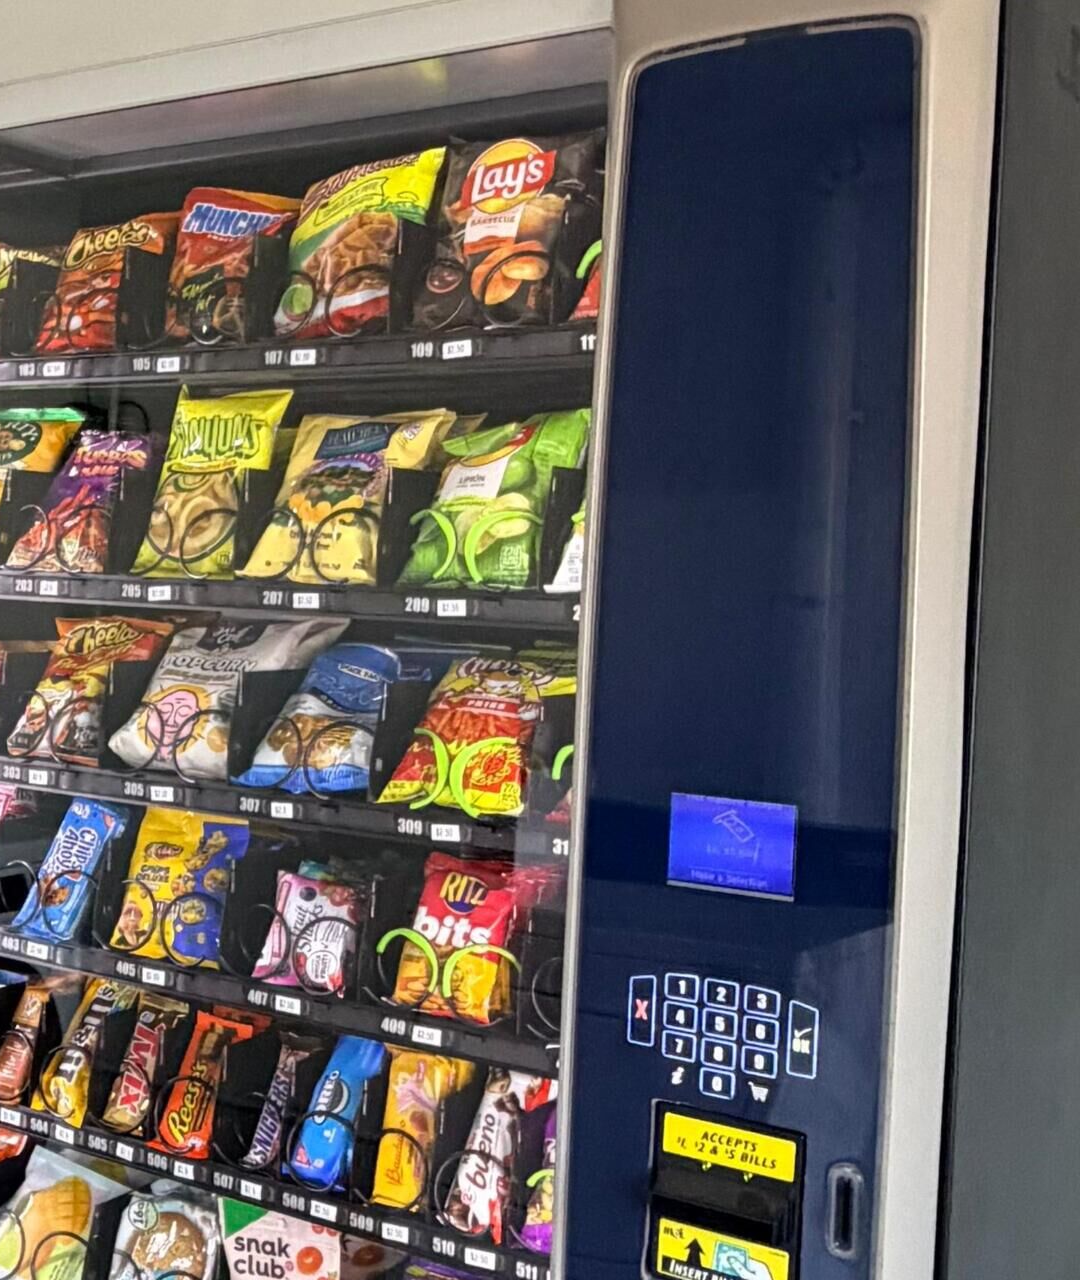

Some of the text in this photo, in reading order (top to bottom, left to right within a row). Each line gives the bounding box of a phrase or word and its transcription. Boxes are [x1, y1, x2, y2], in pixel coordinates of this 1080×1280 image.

[471, 153, 545, 205] Lay's
[411, 342, 433, 357] 109
[580, 334, 596, 351] 11
[132, 356, 151, 371] 105
[265, 351, 282, 365] 107
[15, 581, 32, 593] 203
[121, 584, 141, 598] 205
[263, 592, 283, 605] 207
[405, 597, 430, 613] 209
[4, 767, 20, 780] 303
[124, 782, 144, 796] 305
[240, 797, 260, 813] 307
[398, 818, 422, 835] 309
[552, 838, 569, 854] 31
[440, 873, 489, 906] RITZ
[413, 906, 492, 950] bits
[116, 961, 136, 977] 405
[248, 989, 268, 1006] 407
[716, 986, 727, 1002] 2
[757, 993, 768, 1010] 3
[675, 1009, 686, 1025] 4
[714, 1016, 726, 1032] 5
[381, 1017, 406, 1035] 409
[755, 1023, 766, 1040] 6
[713, 1046, 724, 1062] 8
[792, 1037, 811, 1055] OK
[117, 1022, 165, 1116] TWIX
[753, 1053, 765, 1070] 9
[711, 1076, 723, 1092] 0
[313, 1070, 340, 1125] OREO
[30, 1116, 49, 1134] 504
[251, 1071, 290, 1164] SNICKERS
[88, 1135, 108, 1151] 505
[701, 1131, 758, 1152] ACCEPTS
[468, 1113, 496, 1190] bueno
[709, 1147, 719, 1156] &
[740, 1154, 777, 1169] BILLS
[147, 1152, 168, 1169] 506
[213, 1172, 233, 1189] 507
[349, 1212, 374, 1232] 509
[234, 1235, 291, 1259] snak
[432, 1236, 456, 1256] 510
[234, 1255, 286, 1280] club
